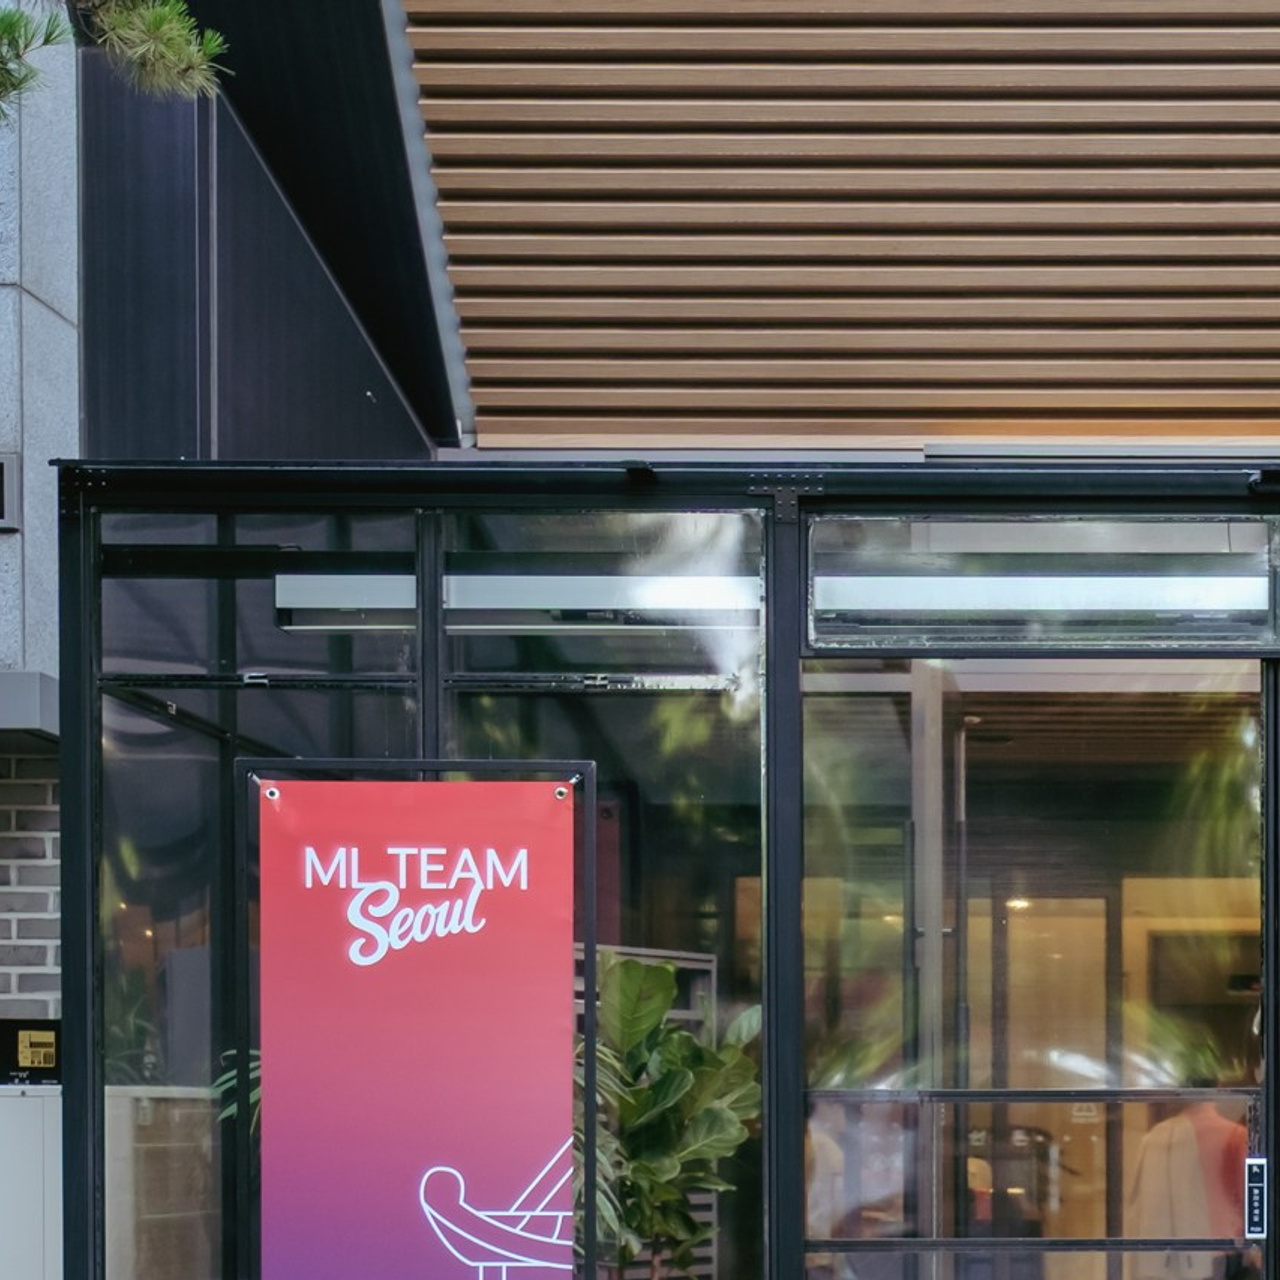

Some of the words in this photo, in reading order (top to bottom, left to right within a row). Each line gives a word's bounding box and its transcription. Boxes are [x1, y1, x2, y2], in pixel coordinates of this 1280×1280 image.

[305, 846, 372, 889] ML
[387, 847, 528, 890] TEAM
[346, 879, 487, 967] Seoul
